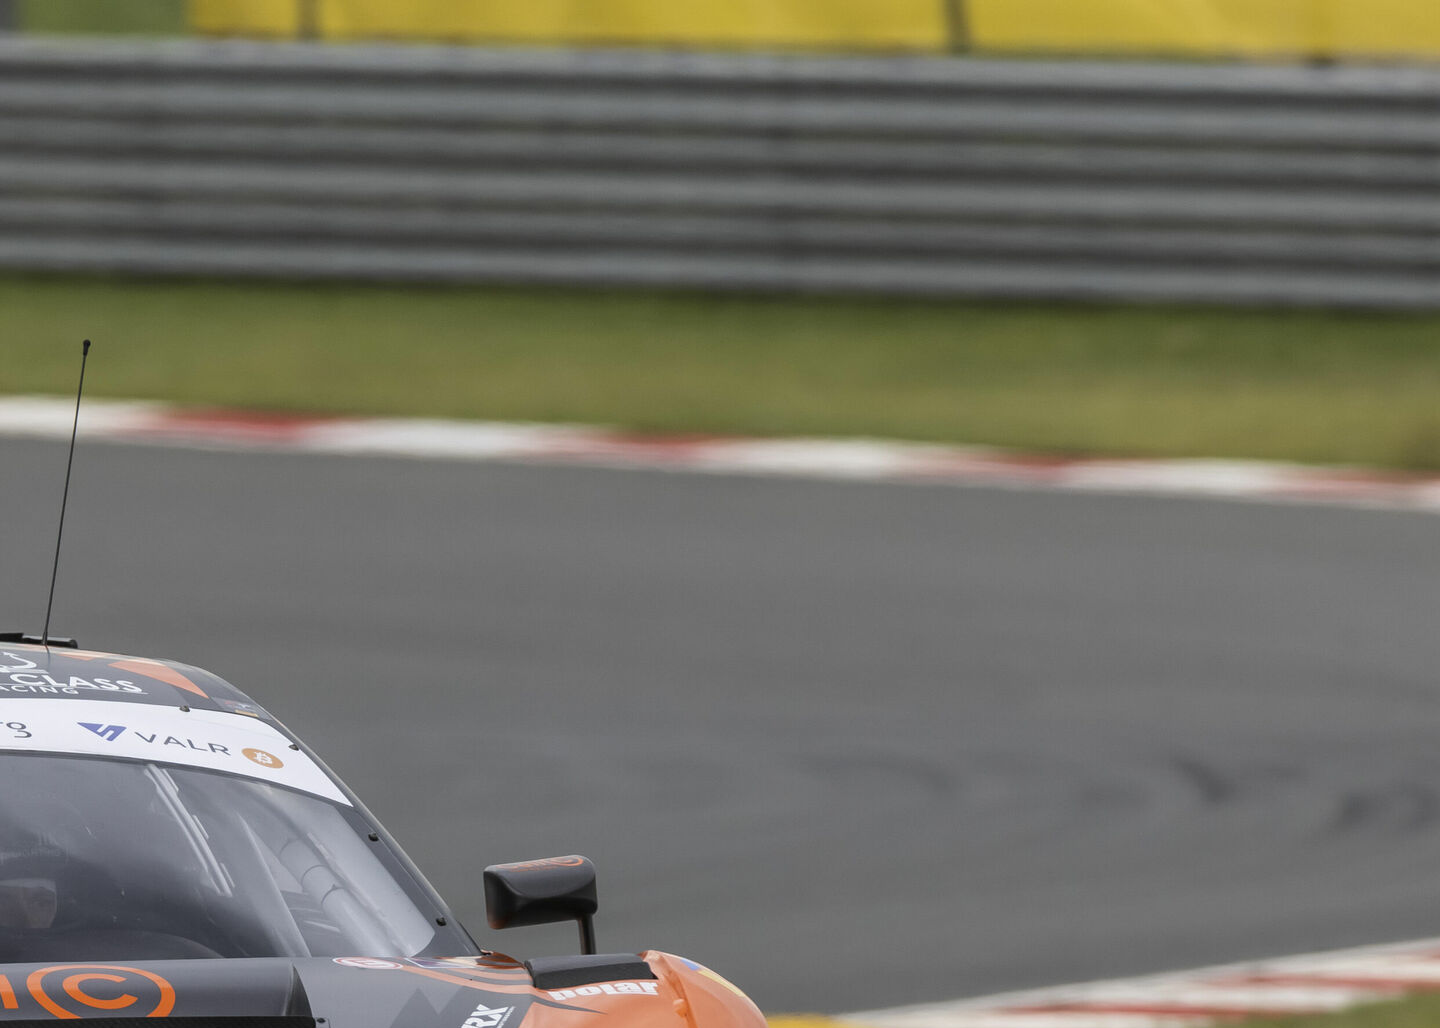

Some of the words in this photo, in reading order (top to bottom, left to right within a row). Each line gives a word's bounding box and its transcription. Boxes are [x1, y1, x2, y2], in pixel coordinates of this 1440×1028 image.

[9, 673, 143, 693] CLASS
[134, 731, 231, 756] VALR
[547, 980, 658, 1001] polar
